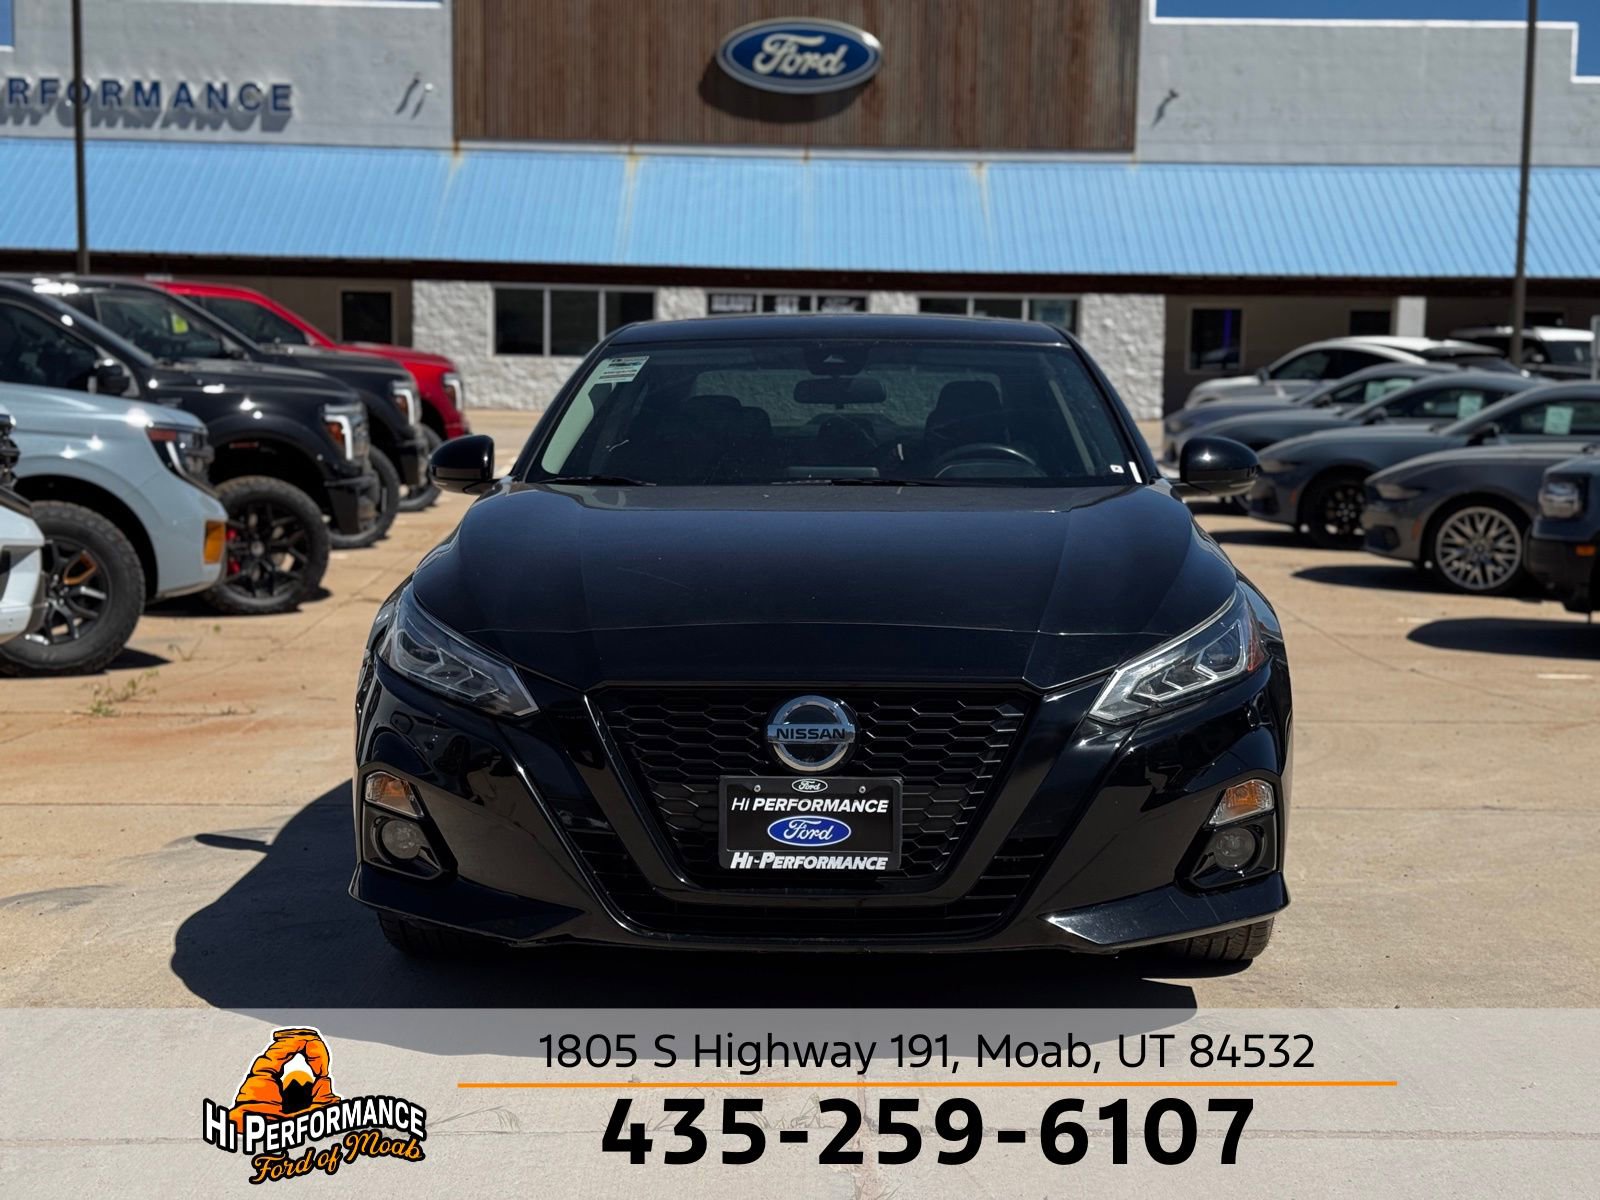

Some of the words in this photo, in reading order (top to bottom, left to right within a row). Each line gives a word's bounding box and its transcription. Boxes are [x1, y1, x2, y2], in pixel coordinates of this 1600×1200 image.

[752, 33, 848, 75] Ford
[776, 728, 845, 740] NISSAN
[798, 781, 821, 791] Ford
[752, 797, 889, 813] PERFORMANCE
[783, 818, 835, 841] Ford
